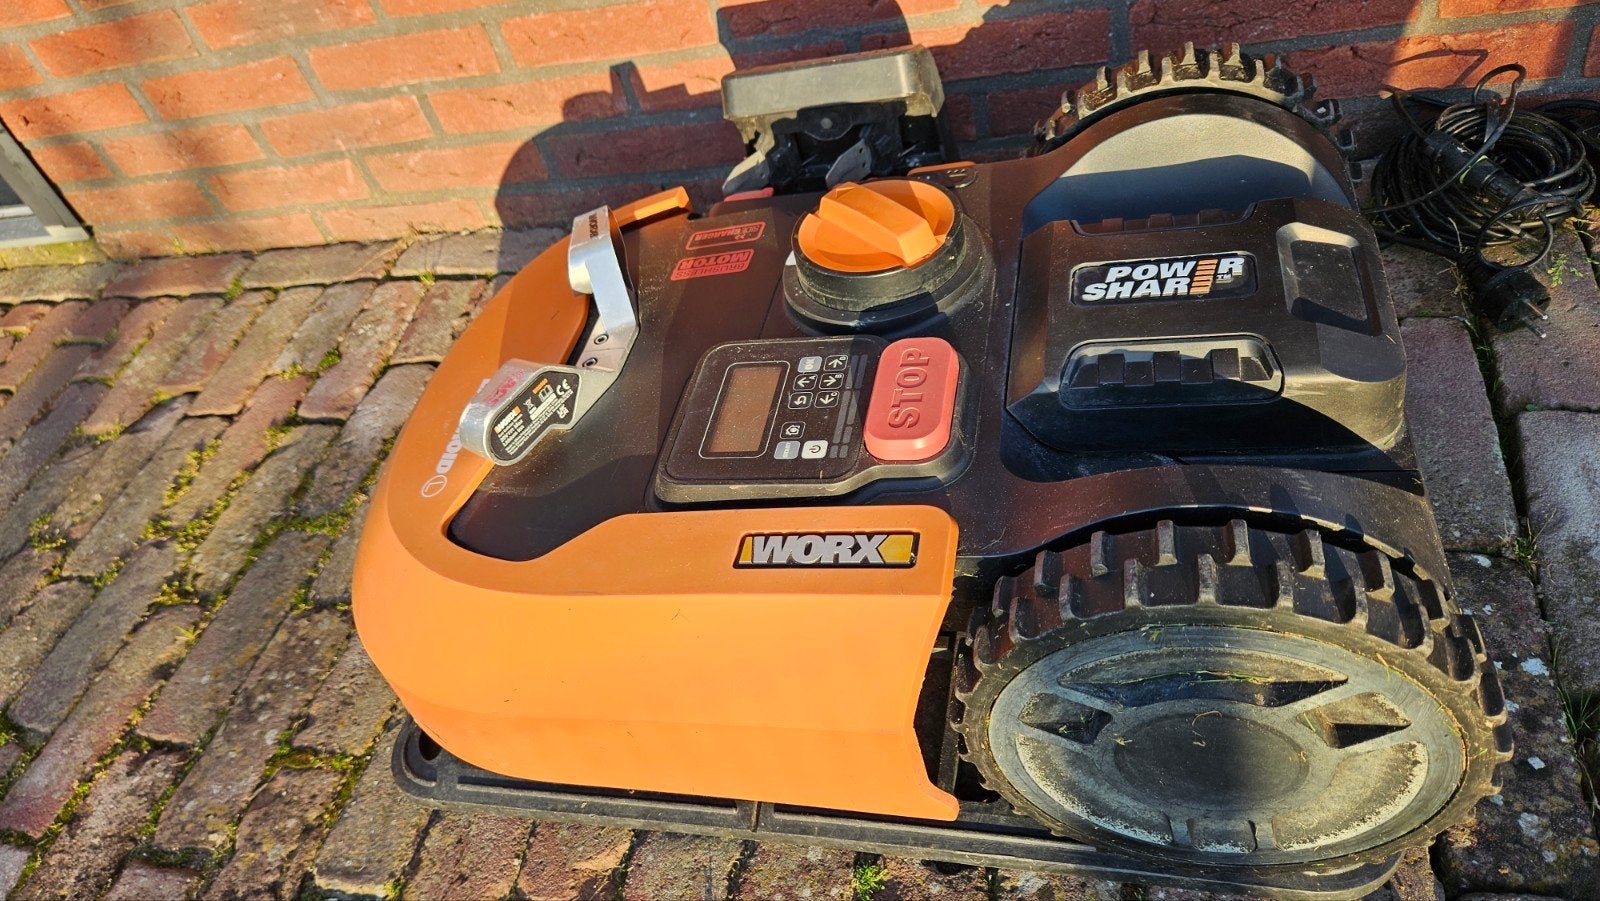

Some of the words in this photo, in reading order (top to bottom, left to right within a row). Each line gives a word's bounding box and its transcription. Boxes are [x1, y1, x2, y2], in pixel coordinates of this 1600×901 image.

[695, 227, 741, 241] CHARGER
[681, 253, 750, 269] MOTOR
[804, 359, 815, 370] OK
[888, 347, 930, 429] STOP
[753, 534, 888, 564] WORX
